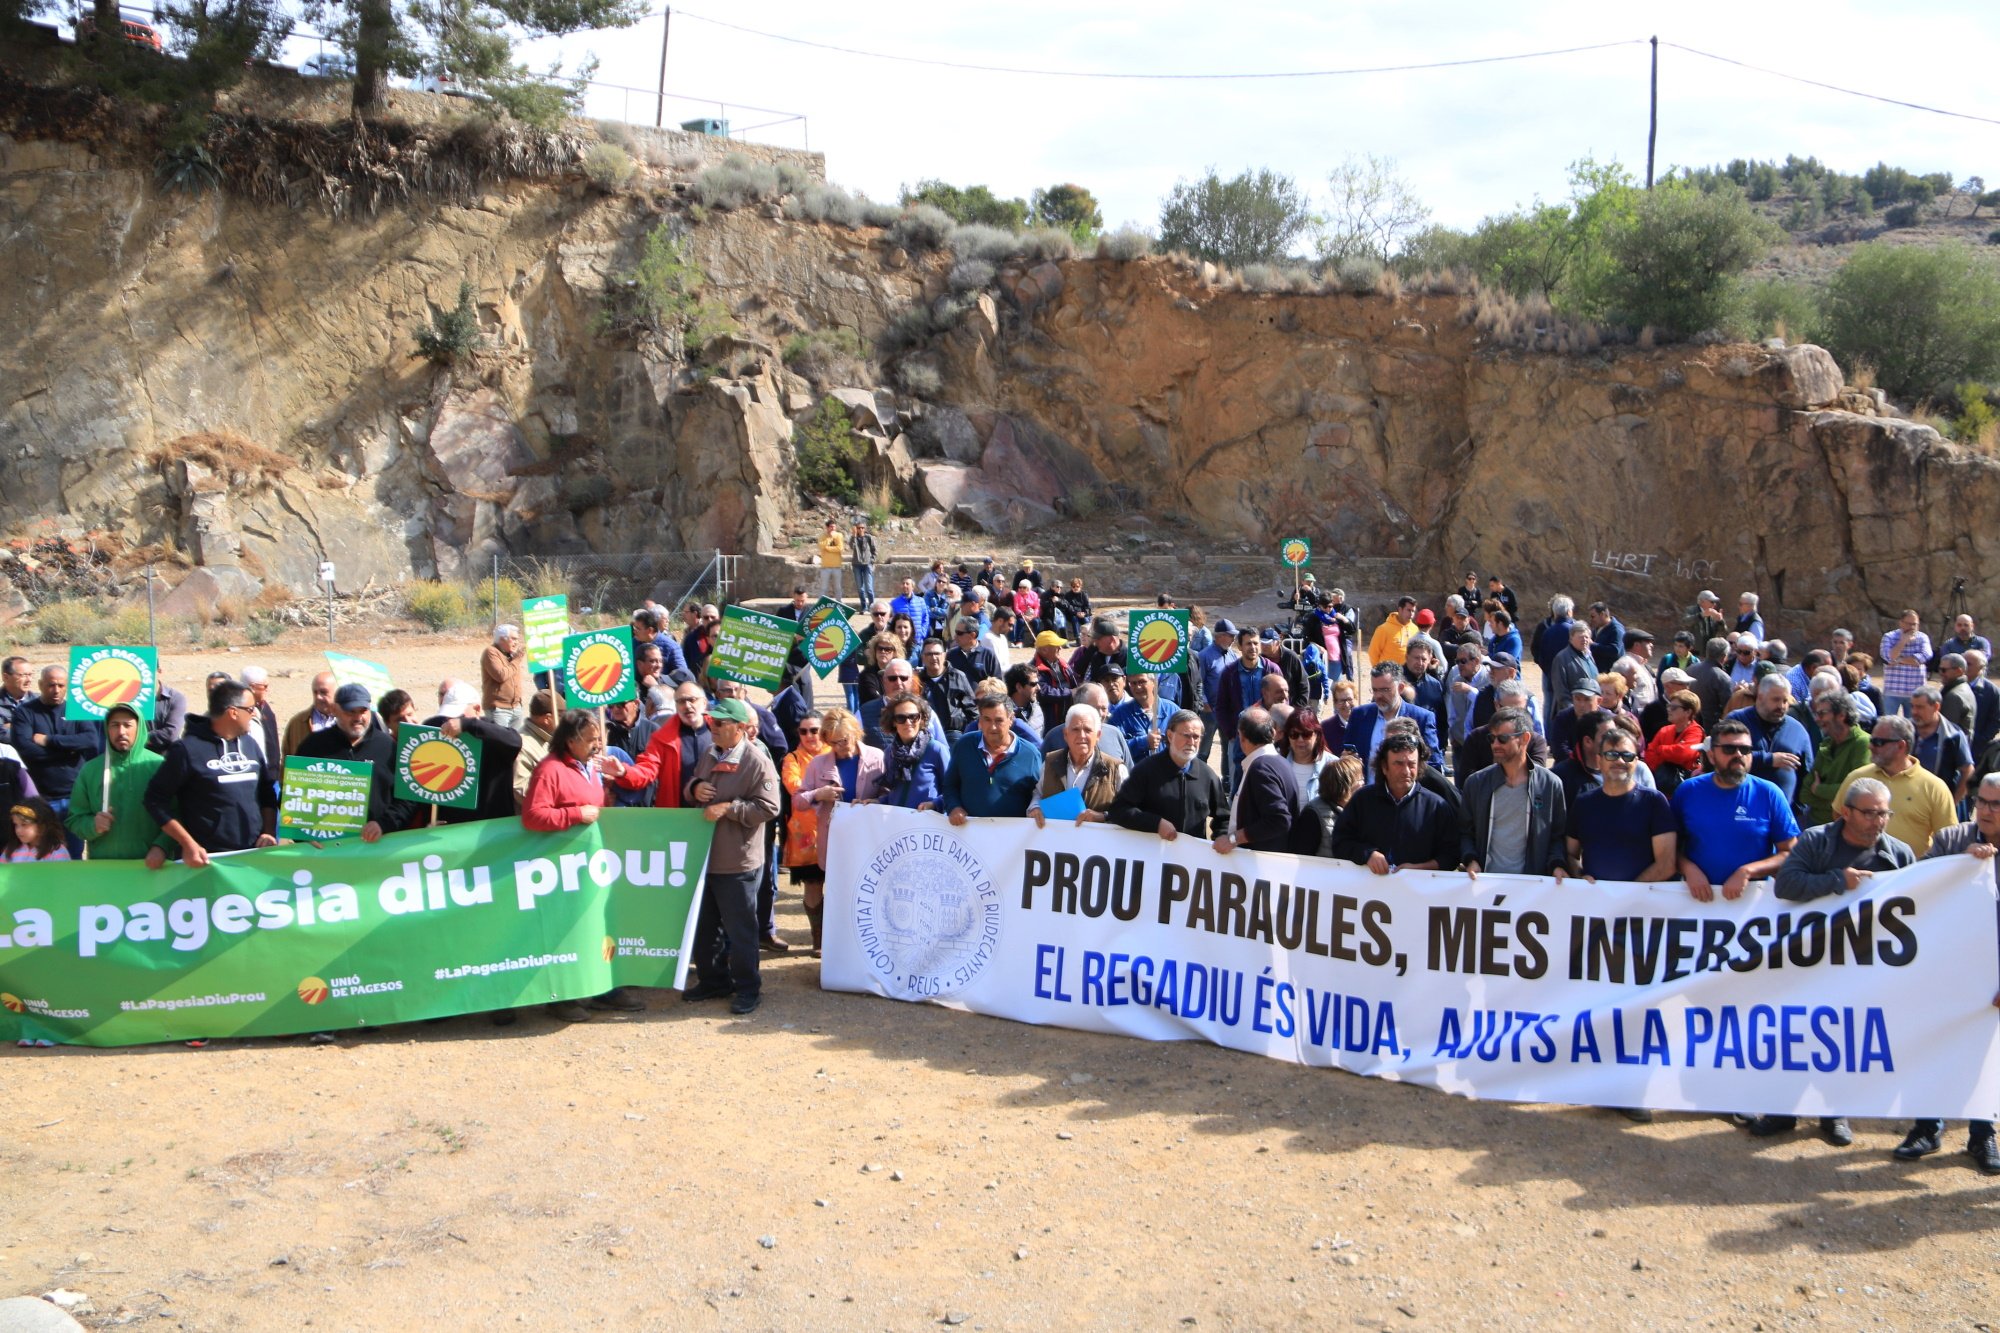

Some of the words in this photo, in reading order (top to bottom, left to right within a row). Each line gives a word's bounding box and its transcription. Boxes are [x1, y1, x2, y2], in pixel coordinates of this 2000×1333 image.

[1591, 550, 1658, 573] LHRT
[818, 618, 836, 631] UNIÓ
[836, 619, 846, 628] DE
[1130, 620, 1145, 644] UNIÓ
[1144, 612, 1157, 623] DE
[1158, 611, 1186, 643] PAGESOS
[720, 631, 736, 642] La
[738, 636, 787, 655] pagesia
[810, 631, 819, 642] DE
[838, 625, 852, 660] PAGESOS
[566, 647, 582, 676] UNIÓ
[579, 635, 595, 649] DE
[595, 633, 631, 666] PAGESOS
[717, 643, 741, 658] diu
[743, 651, 785, 668] prou!
[808, 643, 838, 669] CATALUNYA
[1130, 646, 1140, 660] DE
[1137, 646, 1186, 671] CATALUNYA
[71, 657, 93, 685] UNIÓ
[91, 649, 111, 662] DE
[111, 648, 153, 685] PAGESOS
[71, 686, 88, 704] DE
[567, 677, 581, 694] DE
[577, 668, 631, 704] CATALUNYA
[399, 736, 419, 764] UNIÓ
[418, 731, 436, 742] DE
[285, 784, 304, 797] La
[307, 788, 366, 802] pagesia
[399, 766, 413, 783] DE
[408, 776, 475, 803] CATALUNYA
[283, 797, 313, 813] diu
[317, 803, 364, 817] prou!
[923, 833, 944, 853] DEL
[870, 834, 918, 876] REGANTS
[860, 873, 879, 895] DE
[975, 880, 996, 900] DE
[79, 869, 360, 957] pagesia
[378, 854, 493, 915] diu
[514, 841, 688, 911] prou!
[1021, 849, 1144, 921] PROU
[1158, 862, 1408, 977] PARAULES,
[1427, 894, 1549, 980] MÉS
[1568, 896, 1918, 985] INVERSIONS
[618, 936, 646, 947] UNIÓ
[856, 897, 895, 975] COMUNITAT
[954, 903, 999, 986] RIUDECANYES
[618, 947, 633, 956] DE
[434, 952, 578, 980] #LaPagesiaDiuProu
[330, 974, 361, 987] UNIÓ
[332, 987, 348, 998] DE
[350, 980, 404, 995] PAGESOS
[908, 974, 940, 996] REUS
[24, 998, 49, 1009] UNIÓ
[29, 1006, 42, 1015] DE
[44, 1007, 90, 1017] PAGESOS
[120, 991, 266, 1011] #LaPagesiaDiuProu
[1034, 943, 1071, 1003] EL
[1082, 950, 1243, 1026] REGADIU
[1252, 966, 1296, 1038] ÉS
[1306, 988, 1411, 1063] VIDA,
[1431, 1007, 1561, 1063] AJUTS
[1570, 1009, 1602, 1063] A
[1612, 1008, 1671, 1066] LA
[1685, 1004, 1895, 1073] PAGESIA
